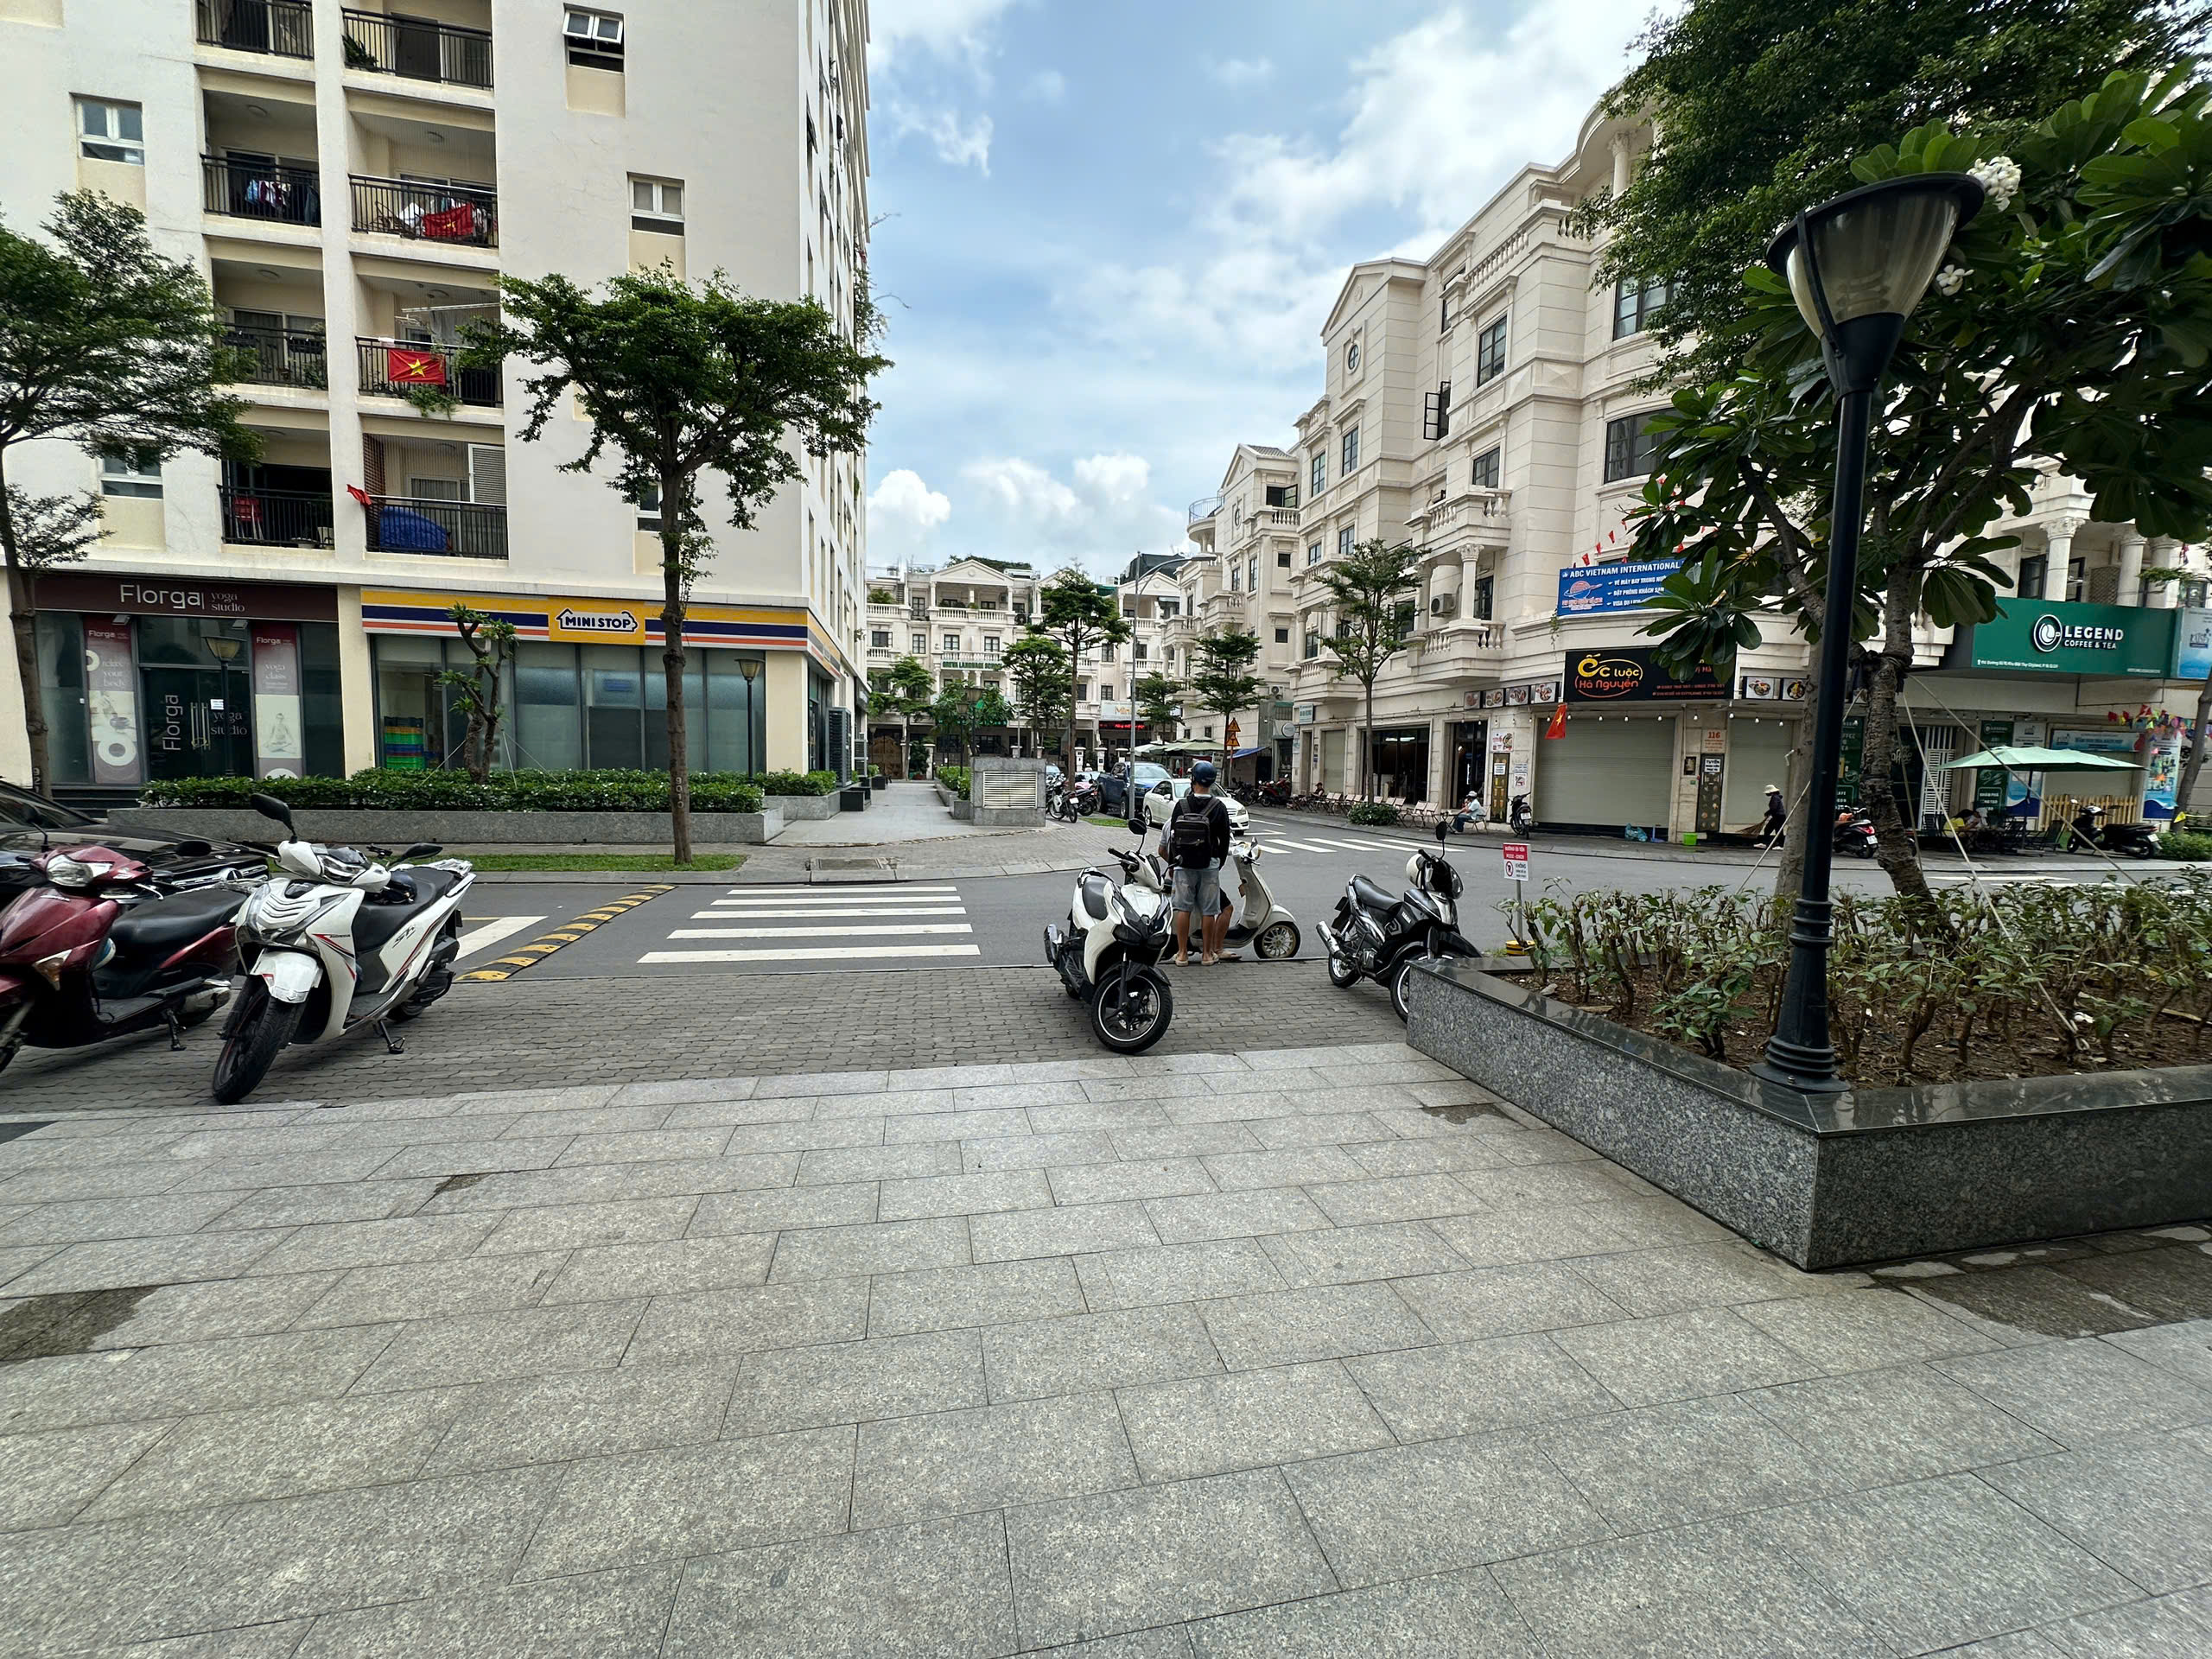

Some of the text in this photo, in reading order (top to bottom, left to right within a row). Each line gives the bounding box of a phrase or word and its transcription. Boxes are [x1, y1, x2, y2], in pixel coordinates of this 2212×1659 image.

[1586, 568, 1618, 577] VIETNAM
[1620, 562, 1680, 574] INTERNATIONAL
[119, 584, 238, 609] Florga yoga
[211, 603, 245, 613] studio
[88, 630, 116, 639] Florga
[2064, 625, 2124, 641] LEGEND
[256, 637, 282, 645] Florga
[2064, 639, 2093, 648] COFFEE
[1614, 668, 1640, 678] luộc
[162, 695, 183, 751] Florga
